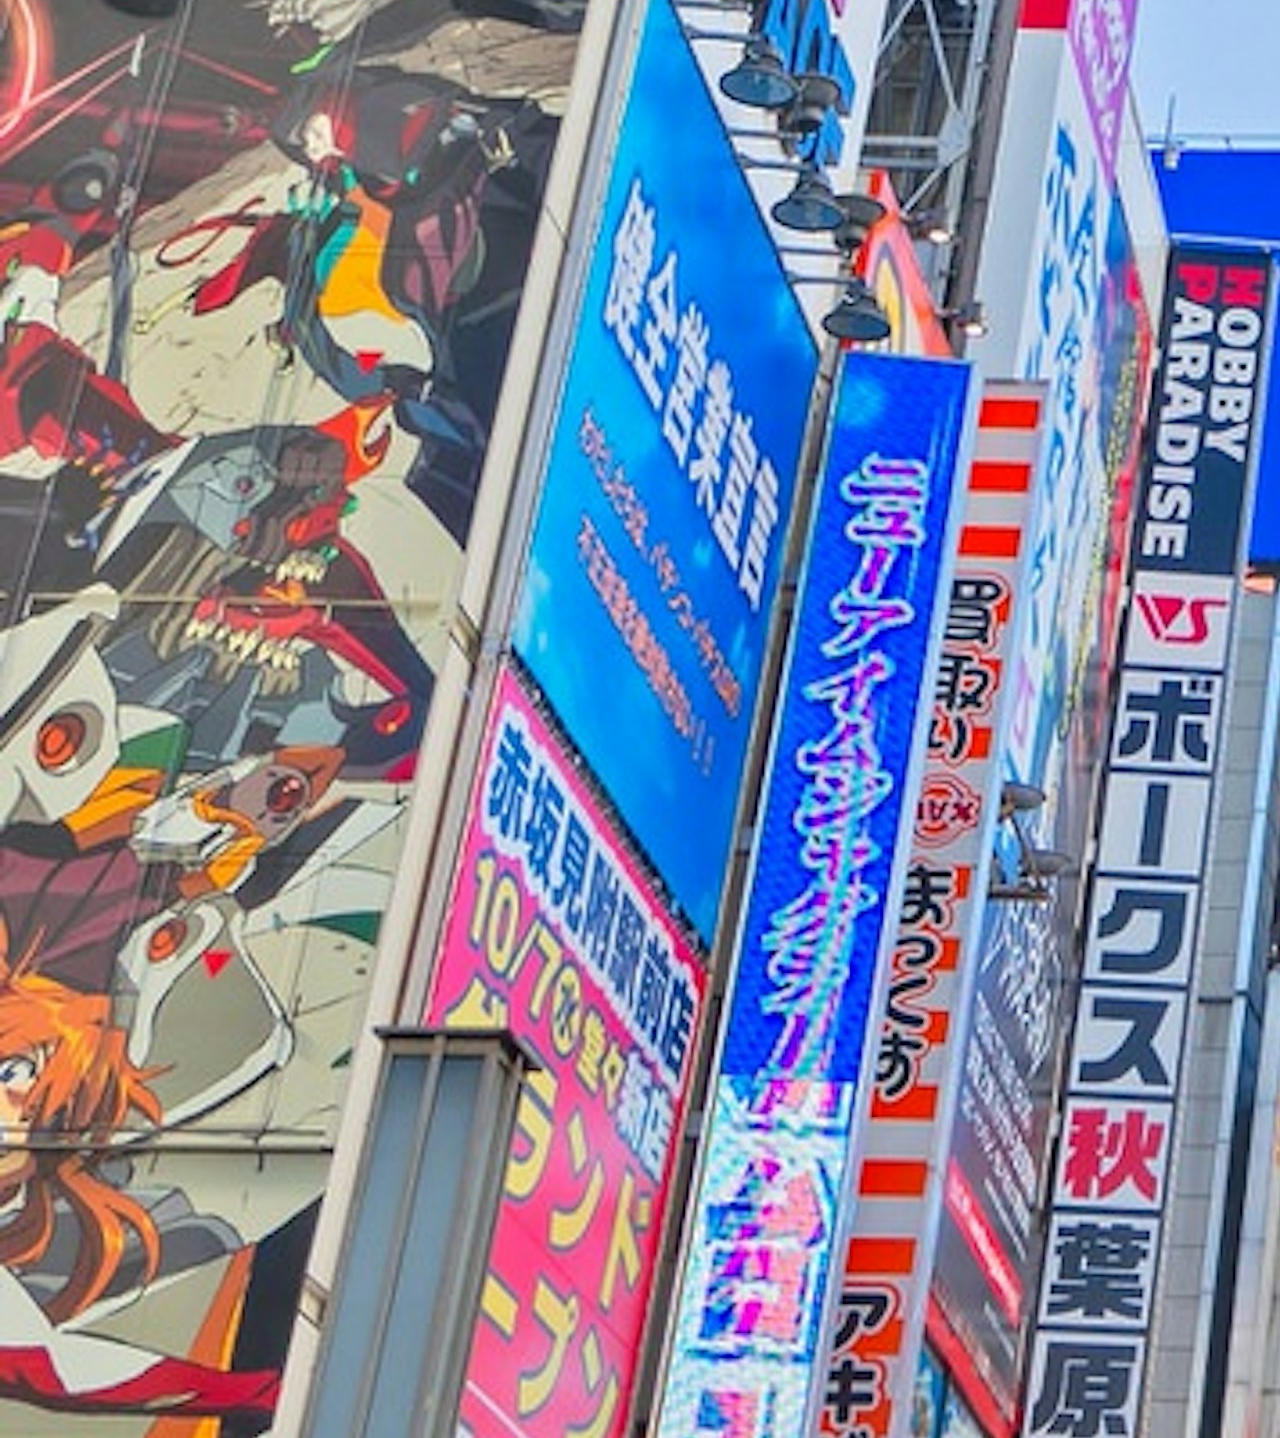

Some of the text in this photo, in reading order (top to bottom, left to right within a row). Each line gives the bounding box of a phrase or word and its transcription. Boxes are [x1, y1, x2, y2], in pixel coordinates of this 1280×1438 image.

[602, 179, 781, 611] 健全営業宣言
[1139, 262, 1216, 560] PARADISE
[1200, 267, 1265, 462] HOBBY
[924, 574, 1004, 761] 買取り
